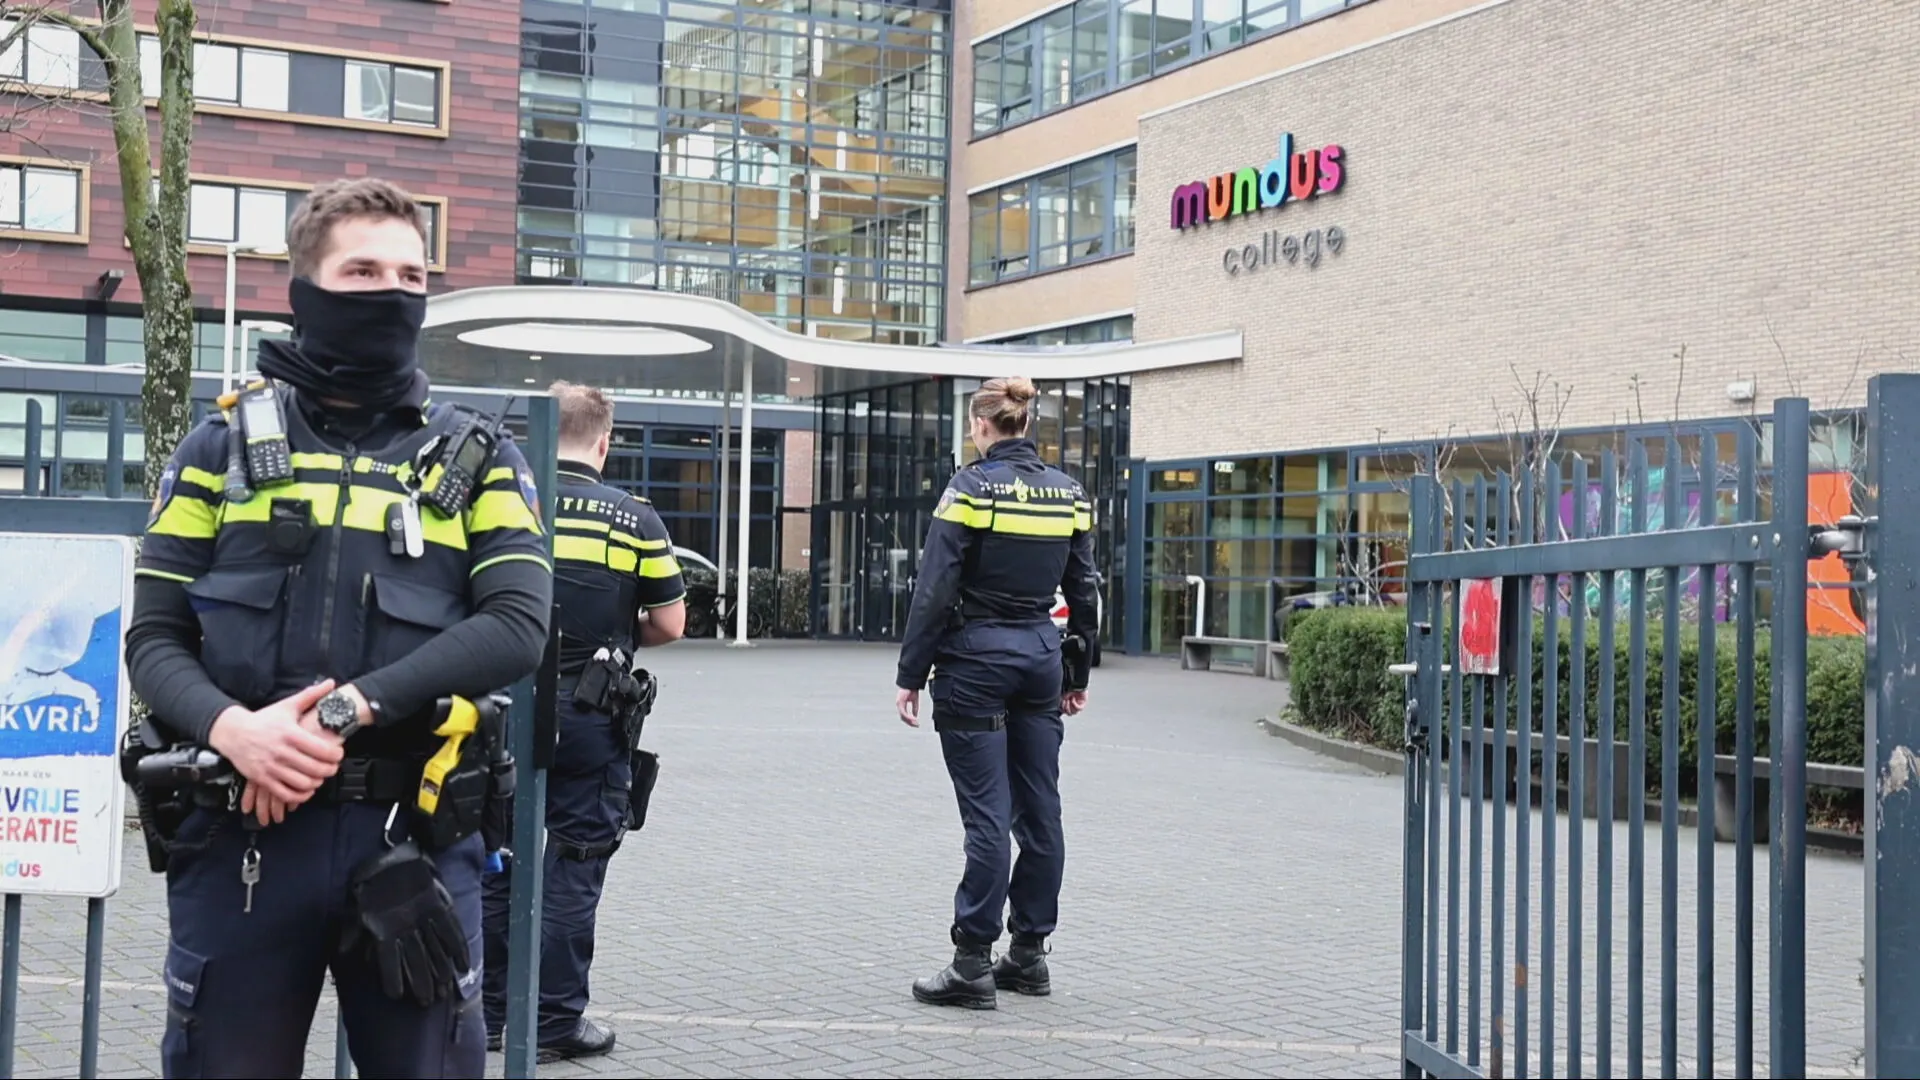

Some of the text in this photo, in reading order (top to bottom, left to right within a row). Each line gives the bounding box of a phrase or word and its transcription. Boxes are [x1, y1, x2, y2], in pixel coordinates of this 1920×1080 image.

[1171, 131, 1345, 230] mundus
[1223, 226, 1345, 277] college
[0, 786, 79, 813] VRIJE
